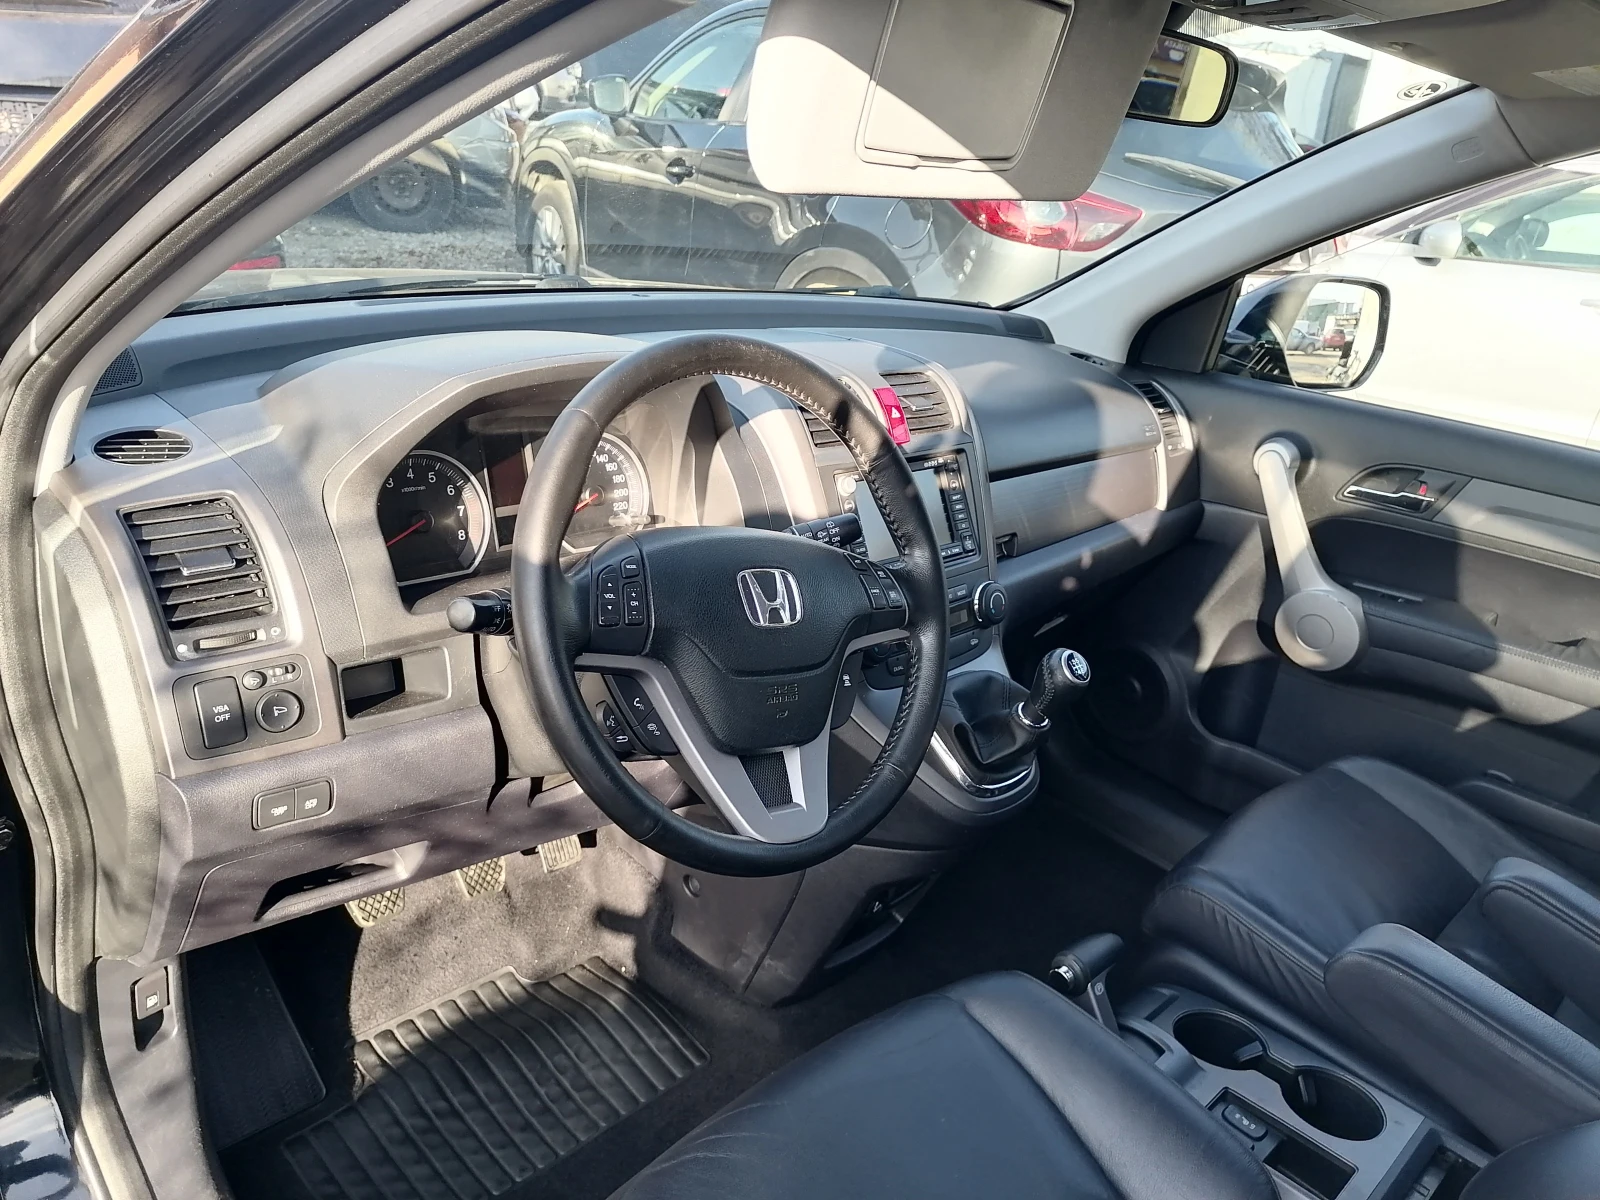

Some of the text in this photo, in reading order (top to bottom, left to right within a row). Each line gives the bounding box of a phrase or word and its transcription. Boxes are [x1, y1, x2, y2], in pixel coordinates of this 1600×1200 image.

[596, 454, 608, 463] 140
[605, 462, 618, 472] 160
[407, 468, 414, 479] 4
[428, 472, 436, 483] 5
[386, 477, 394, 488] 3
[612, 474, 625, 484] 180
[447, 485, 455, 496] 6
[614, 488, 628, 498] 200
[457, 505, 465, 517] 7
[613, 501, 628, 511] 220
[458, 530, 466, 541] 8
[829, 527, 840, 535] OFF
[767, 684, 798, 695] SRS
[766, 694, 799, 705] AIRBAG
[212, 705, 229, 713] VSA
[214, 714, 231, 723] OFF
